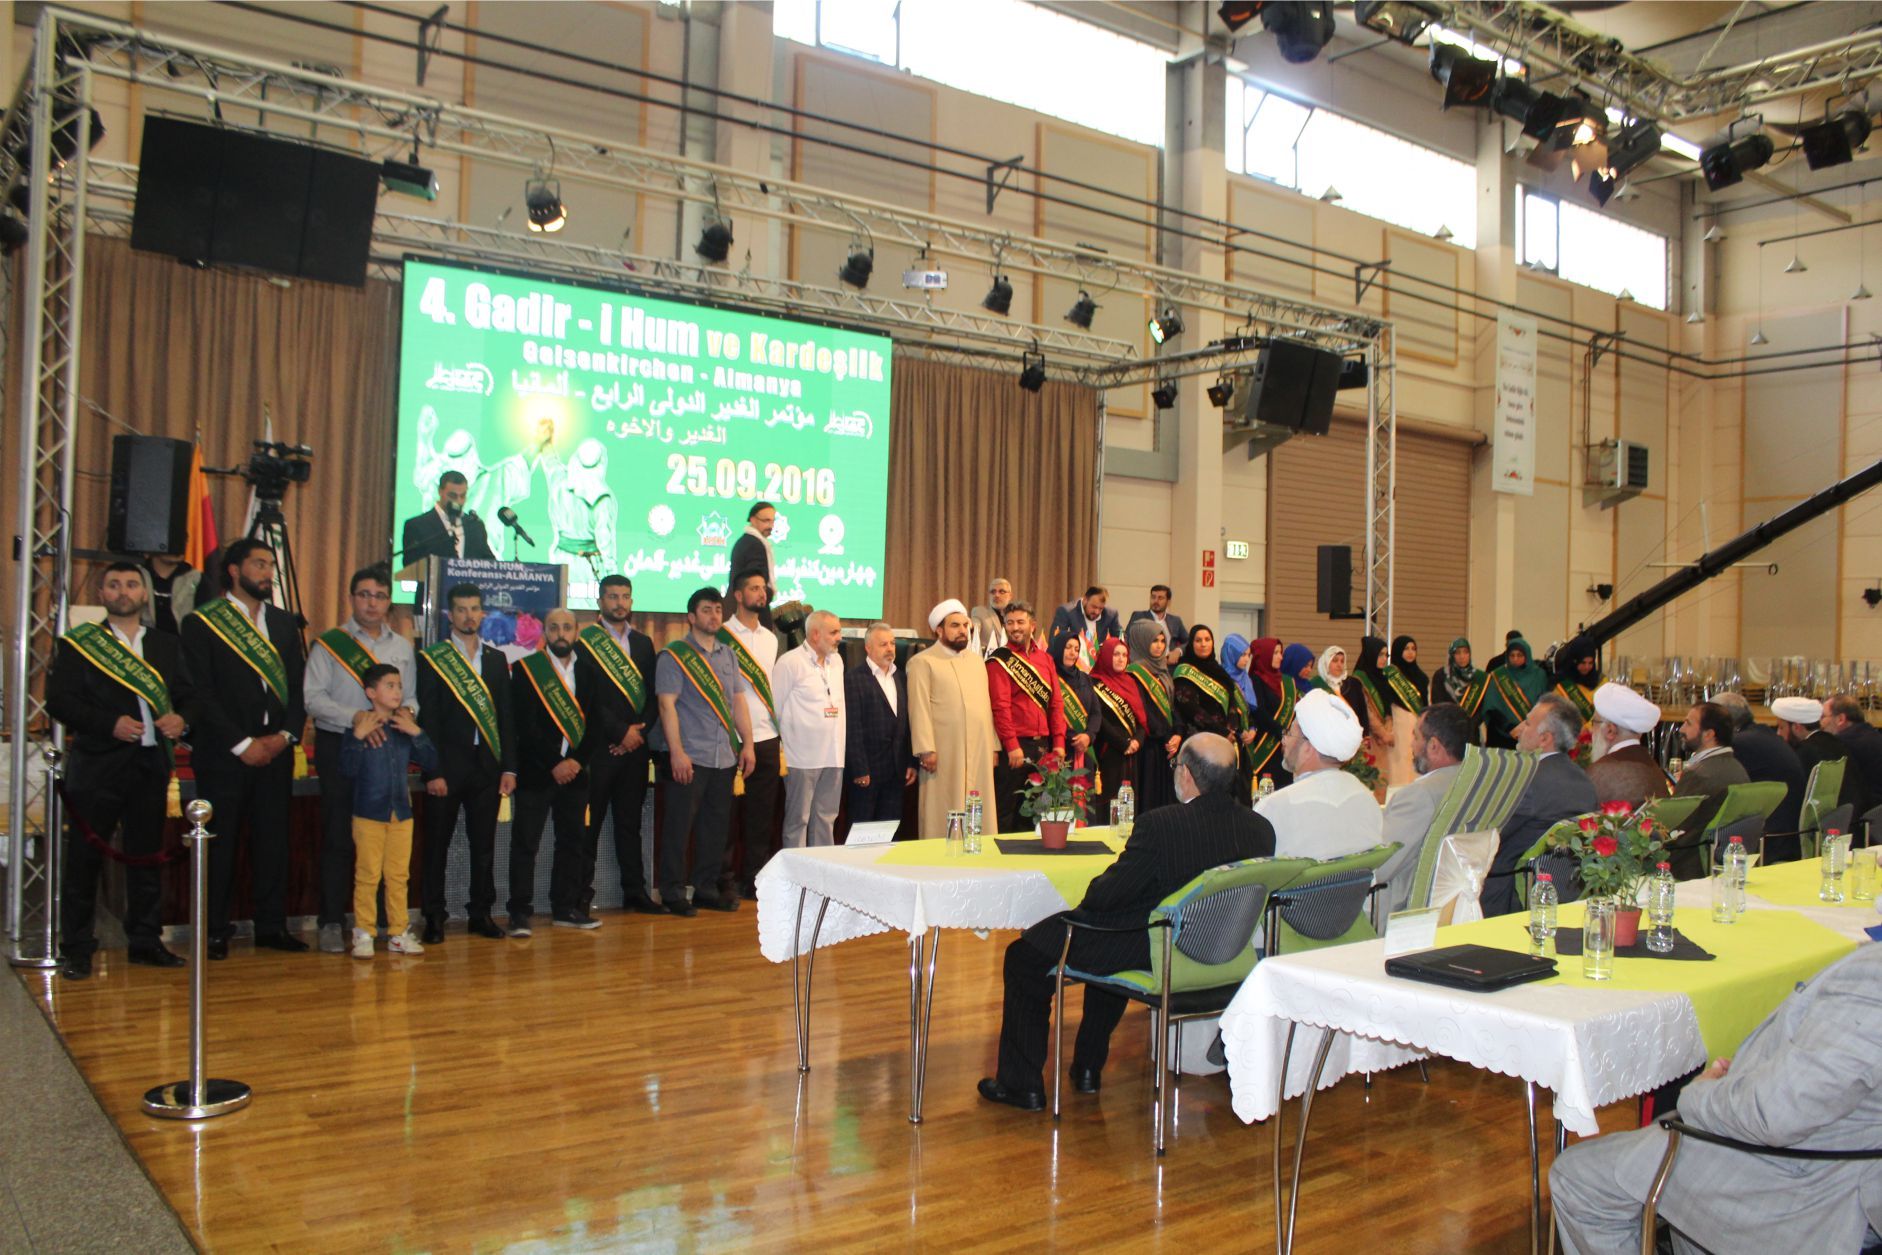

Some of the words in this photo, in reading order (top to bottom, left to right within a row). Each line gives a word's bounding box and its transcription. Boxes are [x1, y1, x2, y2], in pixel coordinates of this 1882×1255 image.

[419, 276, 456, 325] 4.
[620, 305, 699, 357] Hum
[706, 330, 740, 360] ve
[713, 366, 802, 398] Almanya
[666, 453, 836, 507] 25.09.2016
